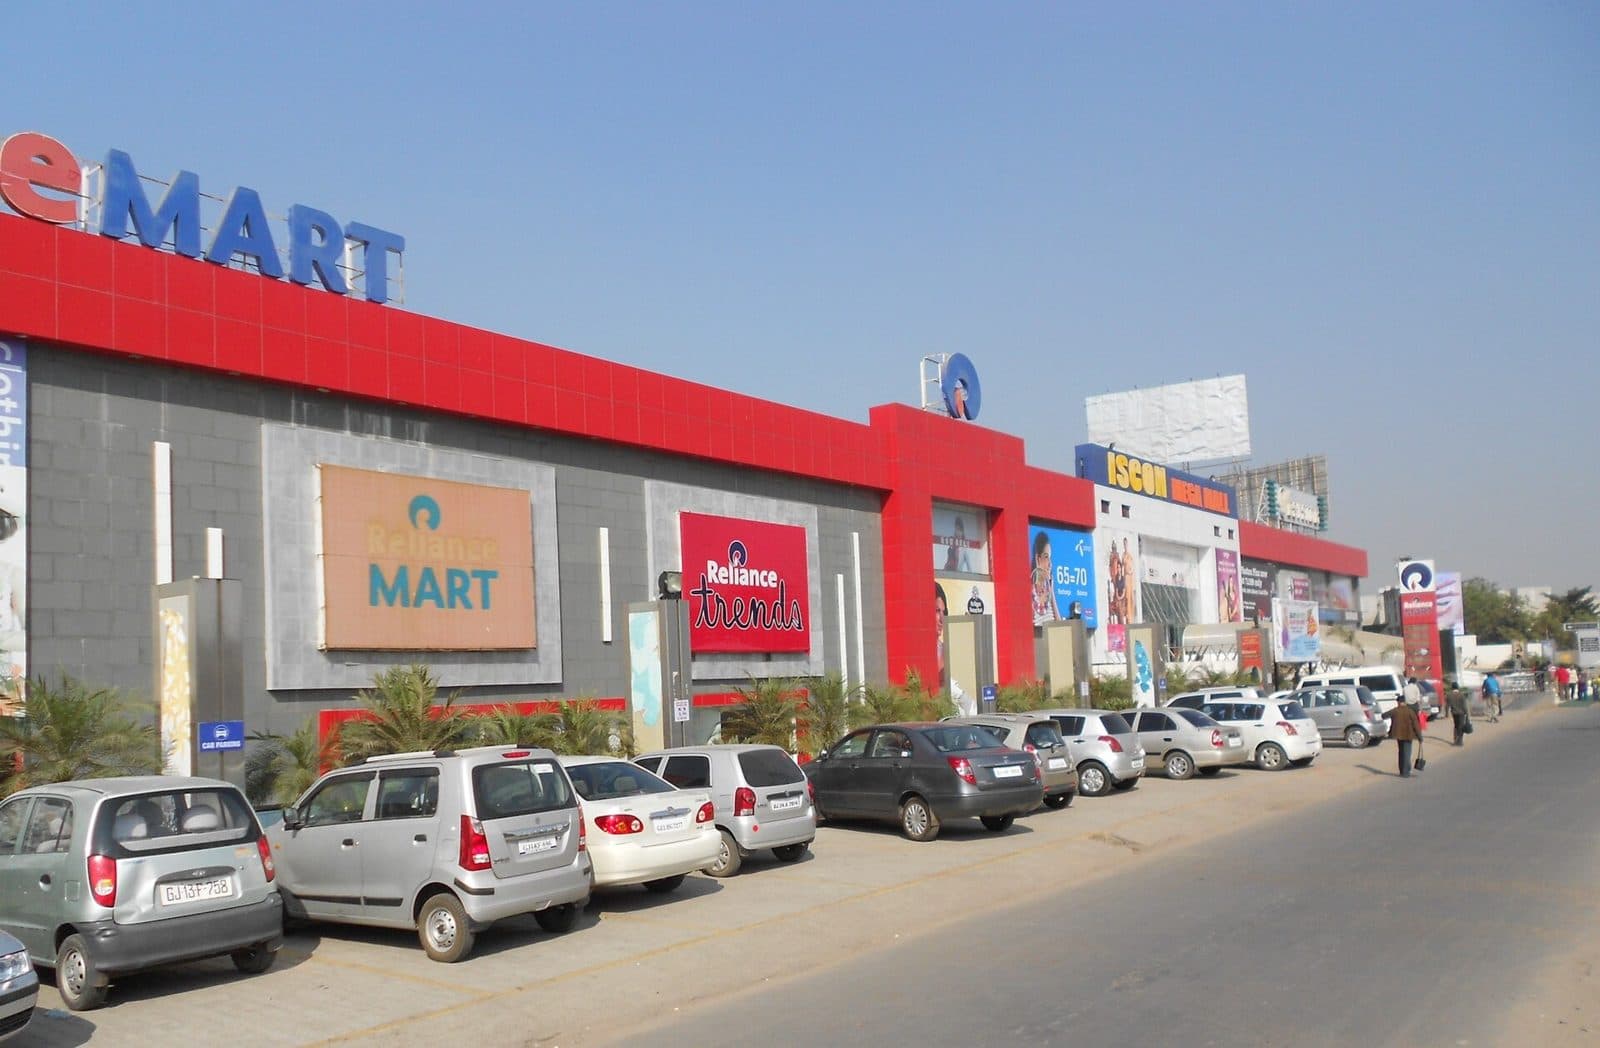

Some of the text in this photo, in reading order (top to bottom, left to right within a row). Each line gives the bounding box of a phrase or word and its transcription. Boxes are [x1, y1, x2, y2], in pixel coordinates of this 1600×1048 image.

[99, 148, 405, 304] MART
[1107, 451, 1167, 498] ISCON
[368, 522, 497, 560] Reliance
[368, 563, 499, 610] MART
[706, 559, 778, 588] Reliance
[690, 573, 804, 631] trends
